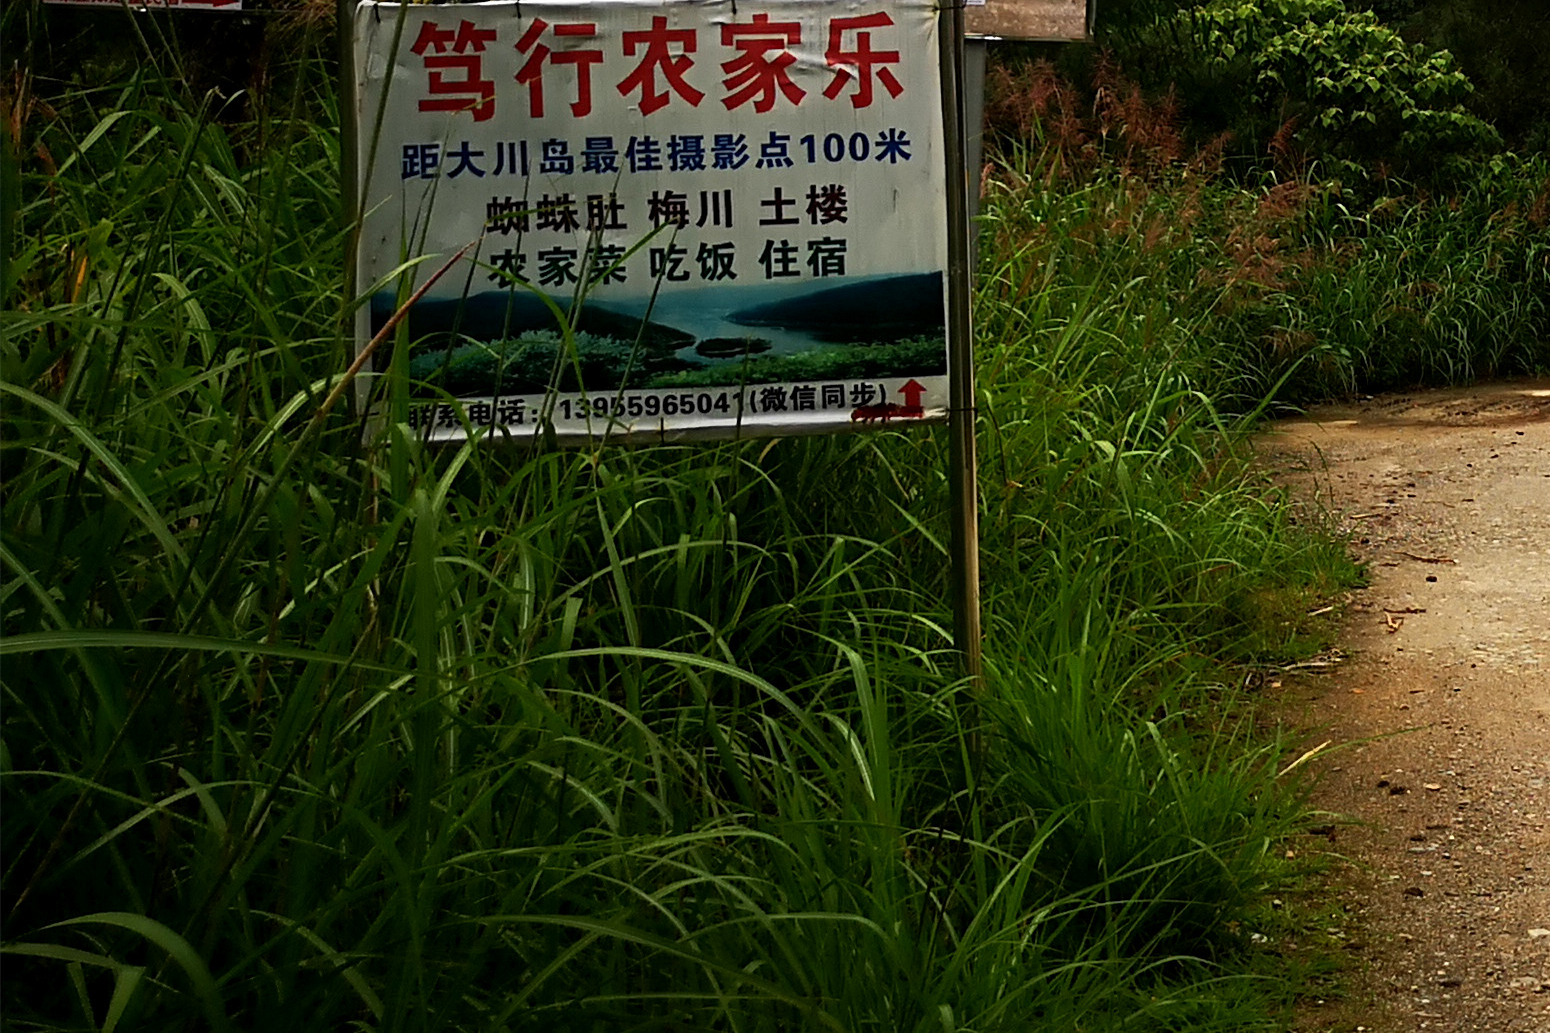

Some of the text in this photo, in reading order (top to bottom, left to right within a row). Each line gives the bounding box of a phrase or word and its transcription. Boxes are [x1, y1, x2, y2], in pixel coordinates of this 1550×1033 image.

[410, 11, 904, 122] 笃行农家乐
[401, 127, 912, 180] 距大川岛最佳摄影点100米
[486, 184, 848, 234] 蜘蛛肚 梅川 土楼
[488, 236, 848, 289] 农家菜 吃饭 住宿
